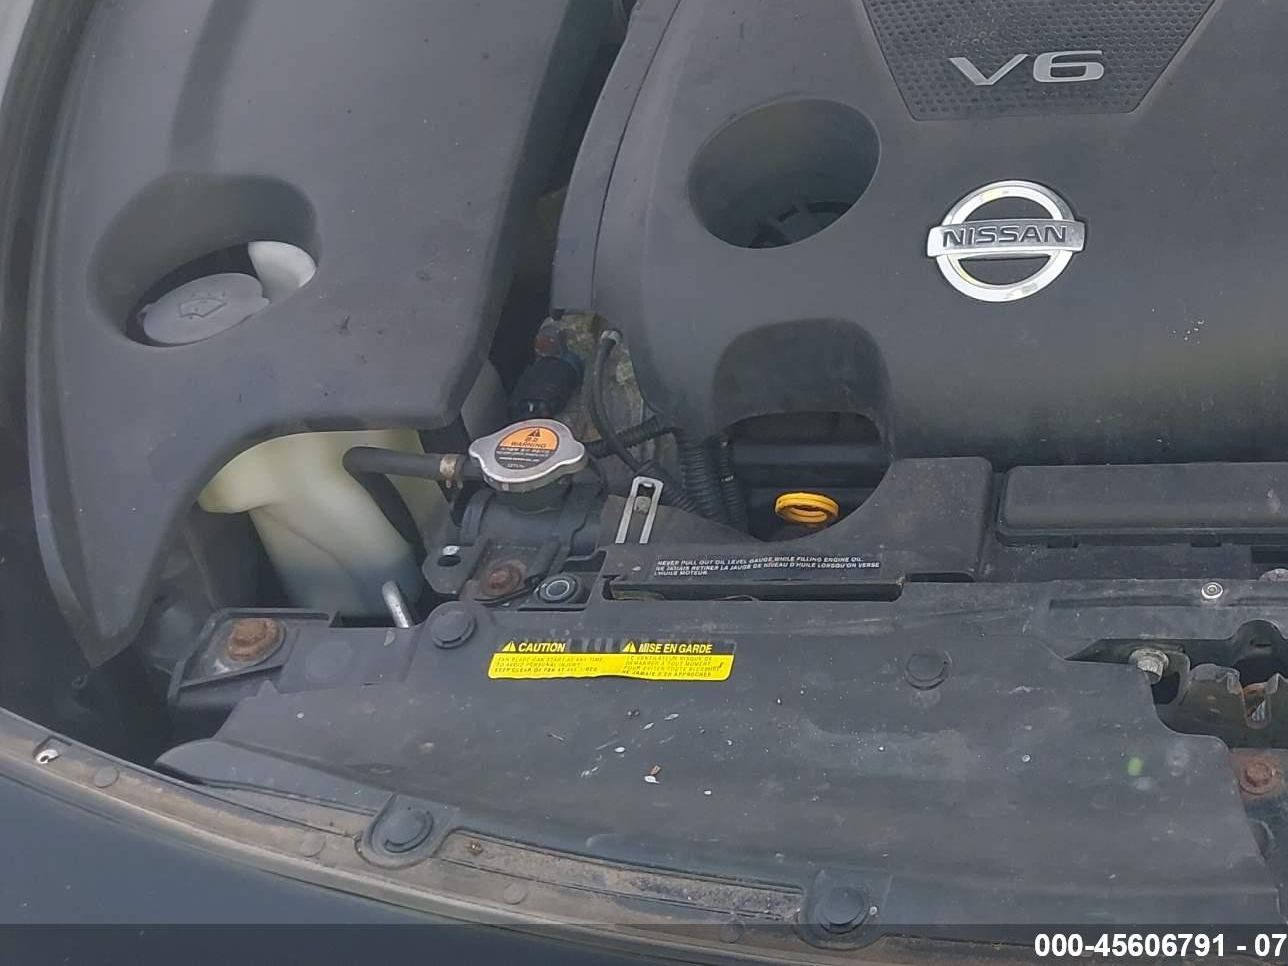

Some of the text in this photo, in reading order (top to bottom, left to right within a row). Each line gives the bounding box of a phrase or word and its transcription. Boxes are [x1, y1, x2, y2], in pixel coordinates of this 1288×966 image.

[950, 50, 1104, 85] V6
[943, 224, 1067, 248] NISSAN
[518, 643, 566, 653] CAUTION
[638, 643, 713, 653] MISE EN GARDE
